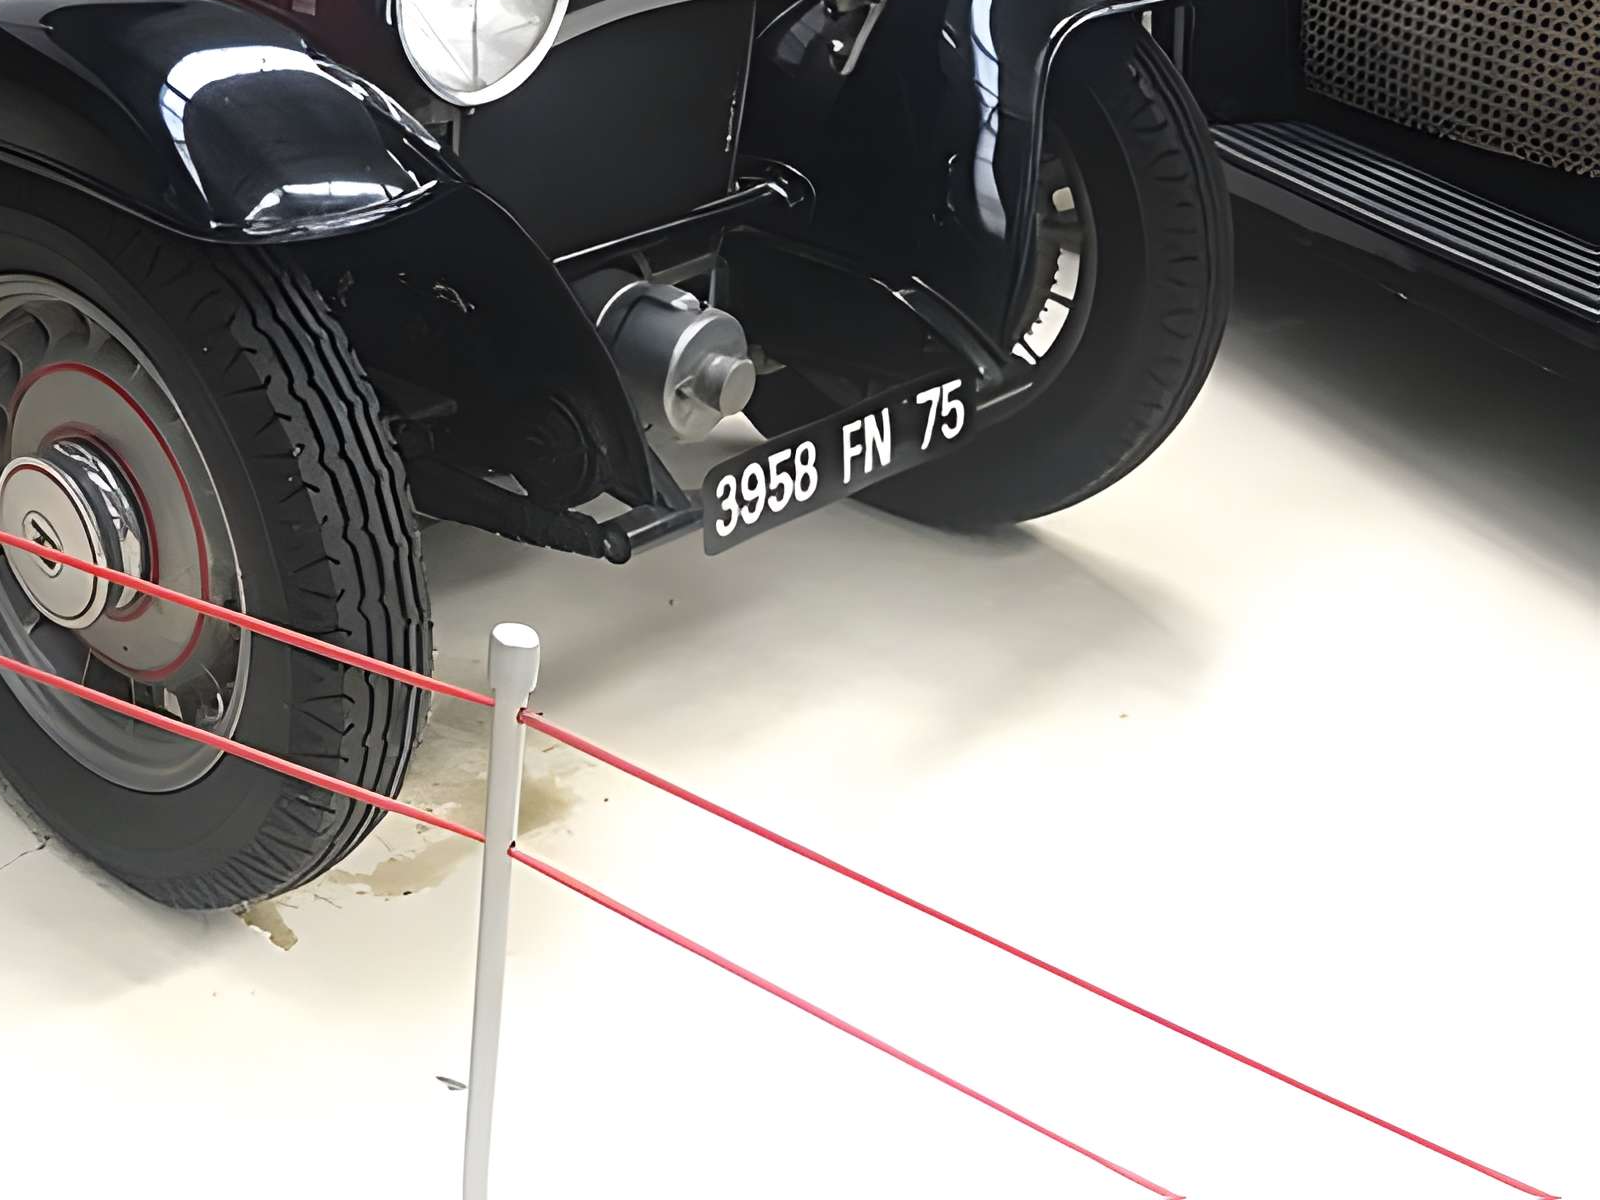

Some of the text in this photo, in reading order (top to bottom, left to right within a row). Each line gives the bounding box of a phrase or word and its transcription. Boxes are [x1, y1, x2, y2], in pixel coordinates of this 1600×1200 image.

[715, 379, 965, 537] 3958 FN 75
